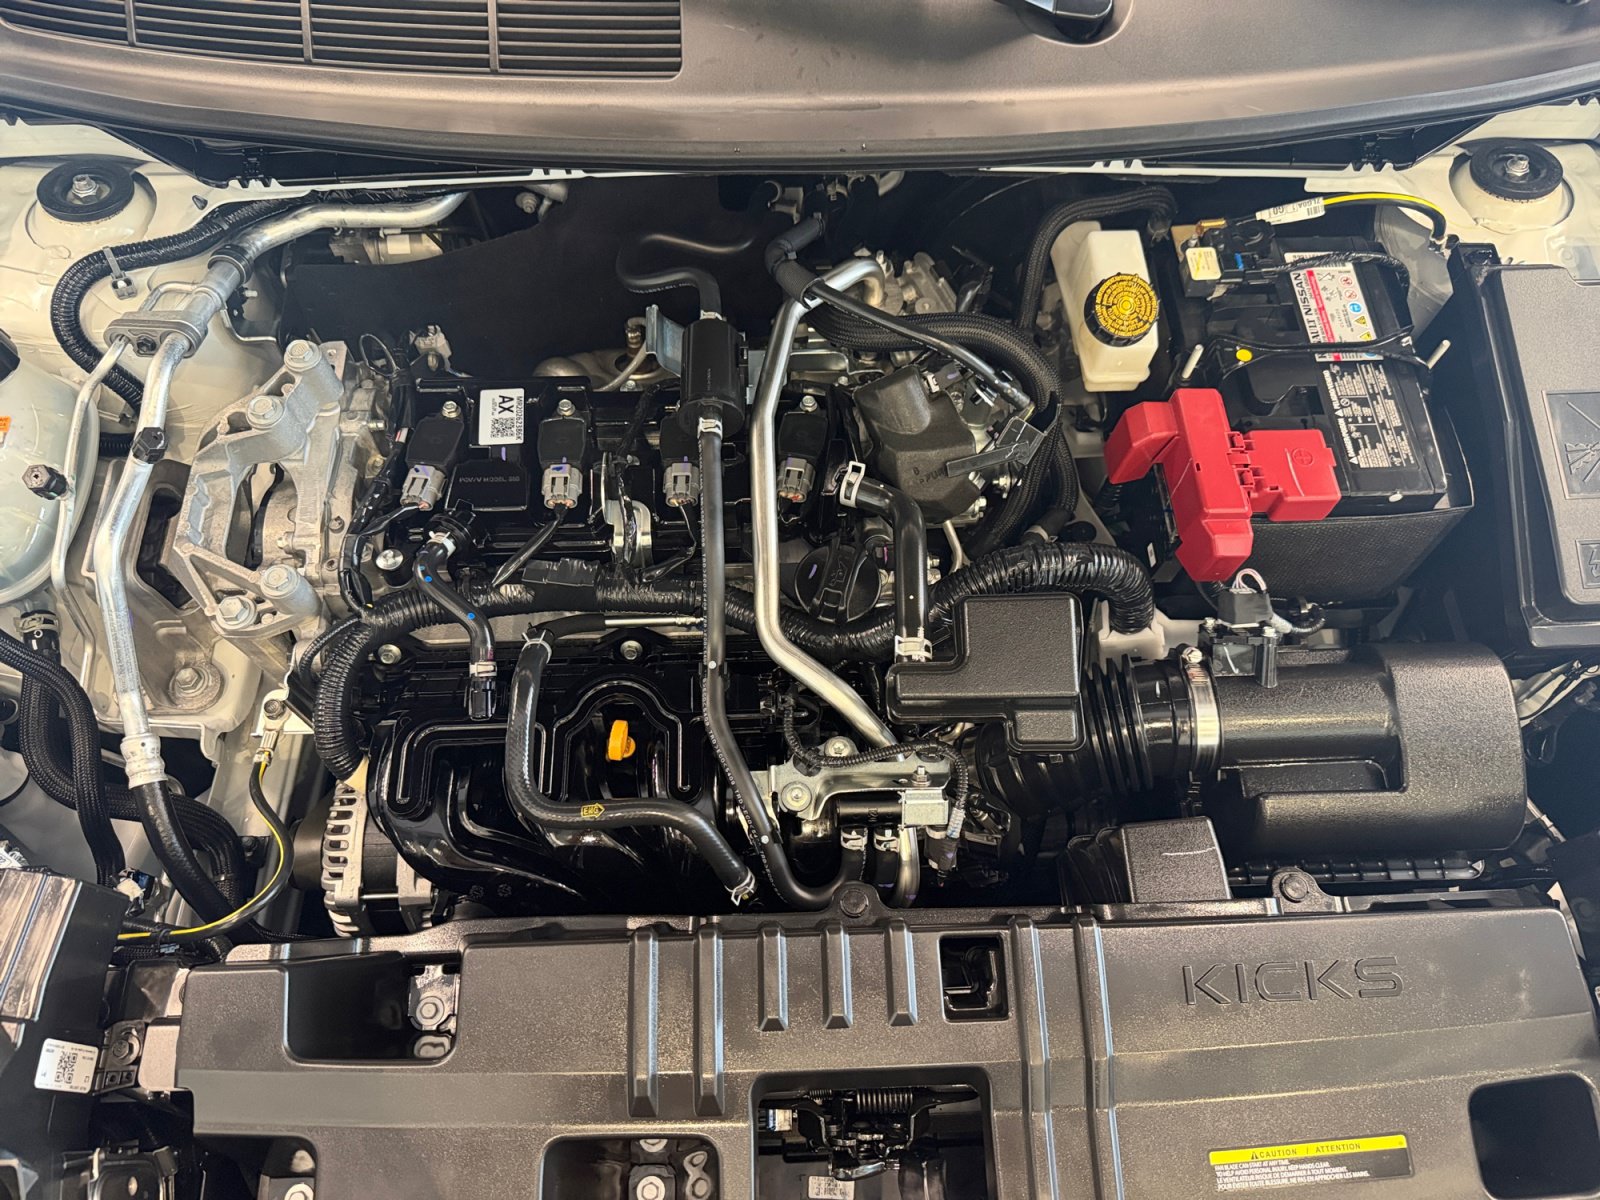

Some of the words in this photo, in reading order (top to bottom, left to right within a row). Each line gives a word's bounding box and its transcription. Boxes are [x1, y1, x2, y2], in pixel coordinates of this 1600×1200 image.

[1293, 272, 1313, 316] NISSAN
[498, 395, 514, 414] AX
[1182, 955, 1404, 1006] KICKS
[1260, 1148, 1297, 1158] CAUTION
[1315, 1143, 1360, 1153] ATTENTION
